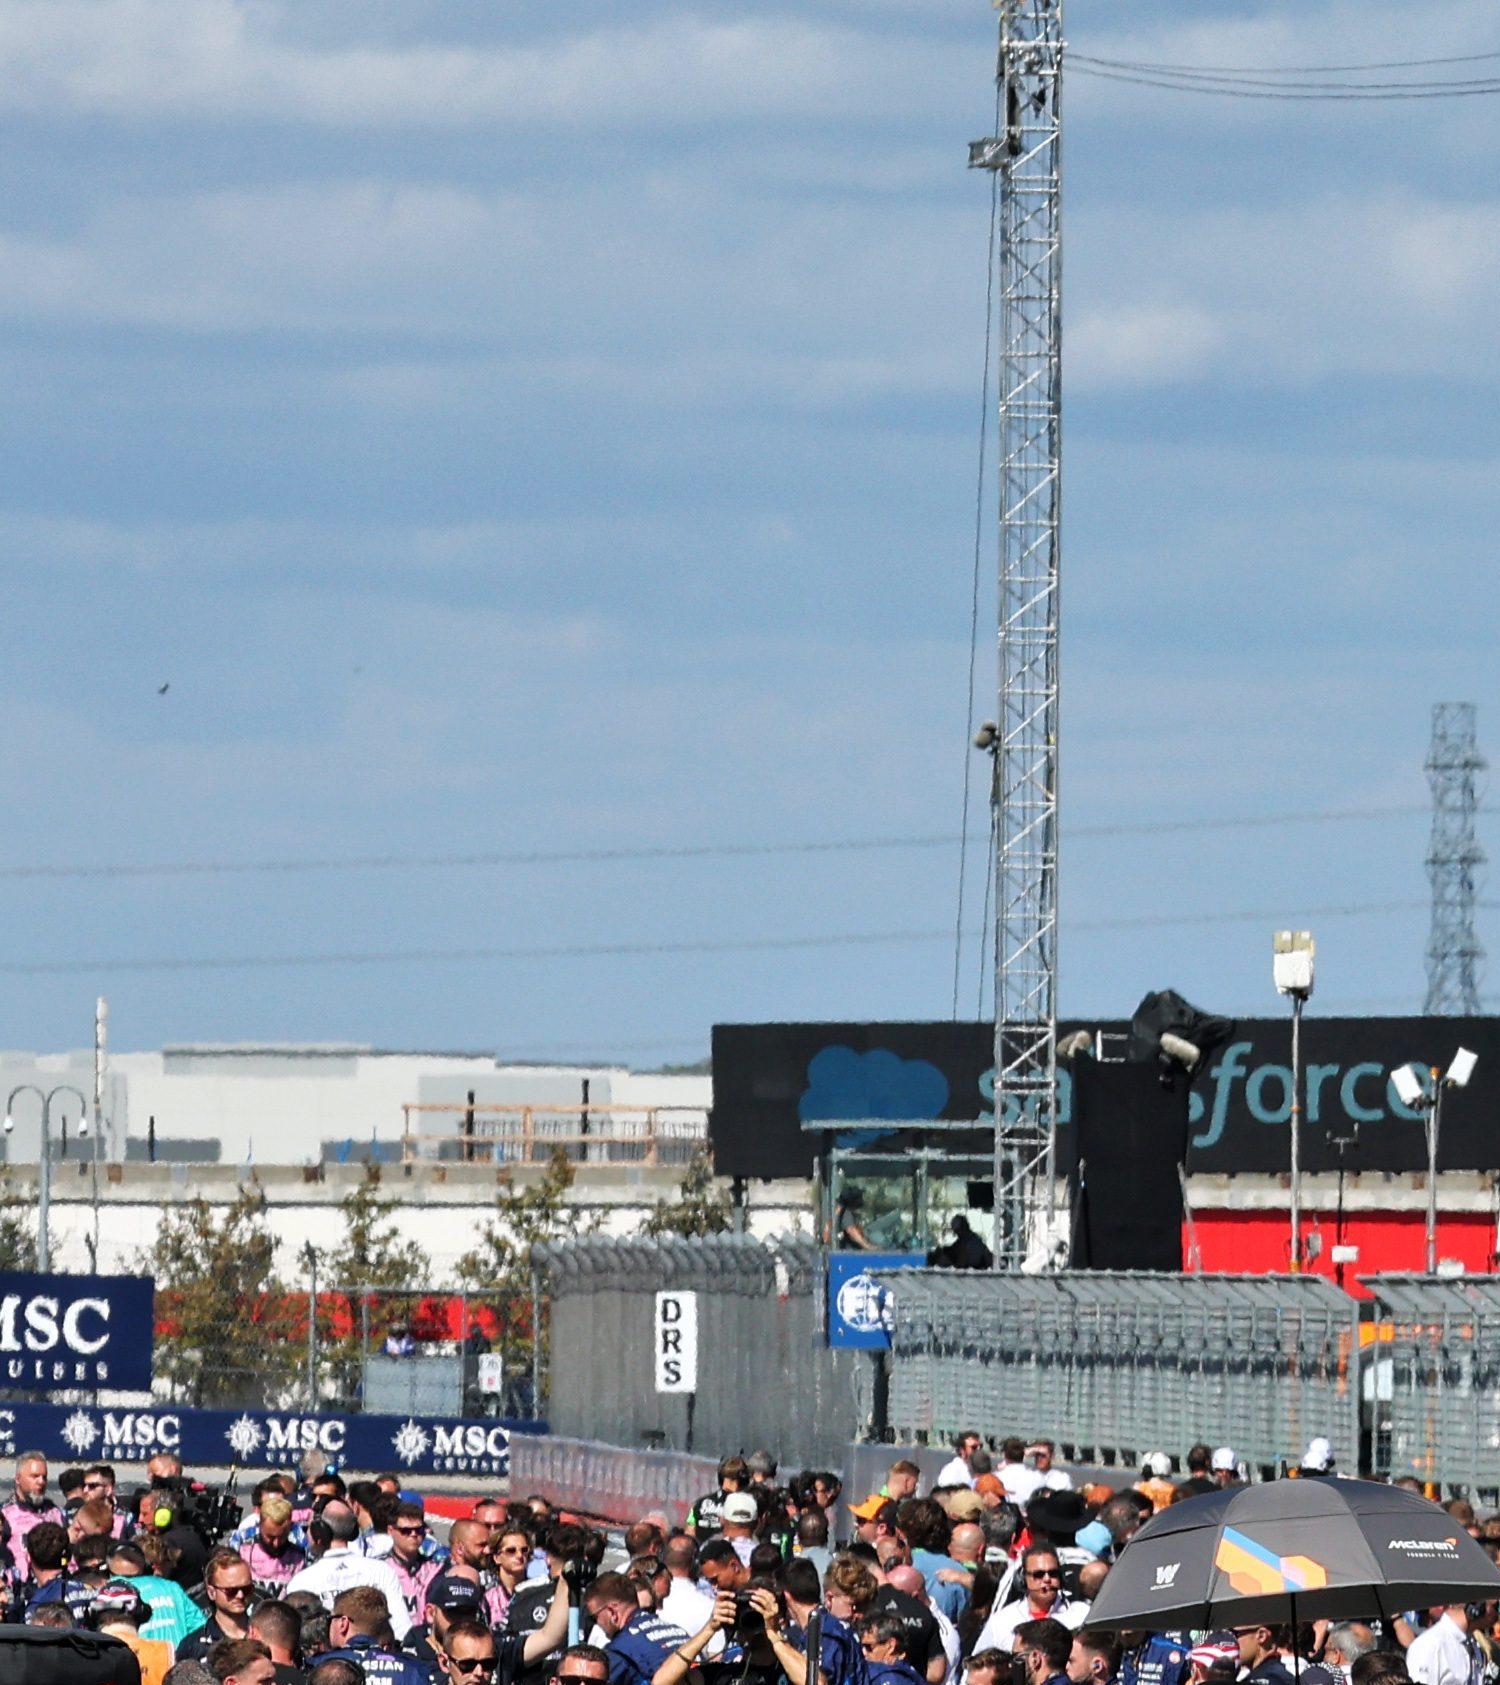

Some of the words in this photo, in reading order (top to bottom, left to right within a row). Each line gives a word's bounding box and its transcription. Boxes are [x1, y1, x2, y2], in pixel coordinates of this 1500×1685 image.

[660, 1291, 684, 1387] DRS
[103, 1414, 181, 1446] MSC
[266, 1417, 346, 1452] MSC
[432, 1424, 510, 1457] MSC
[1388, 1539, 1455, 1552] McLaren
